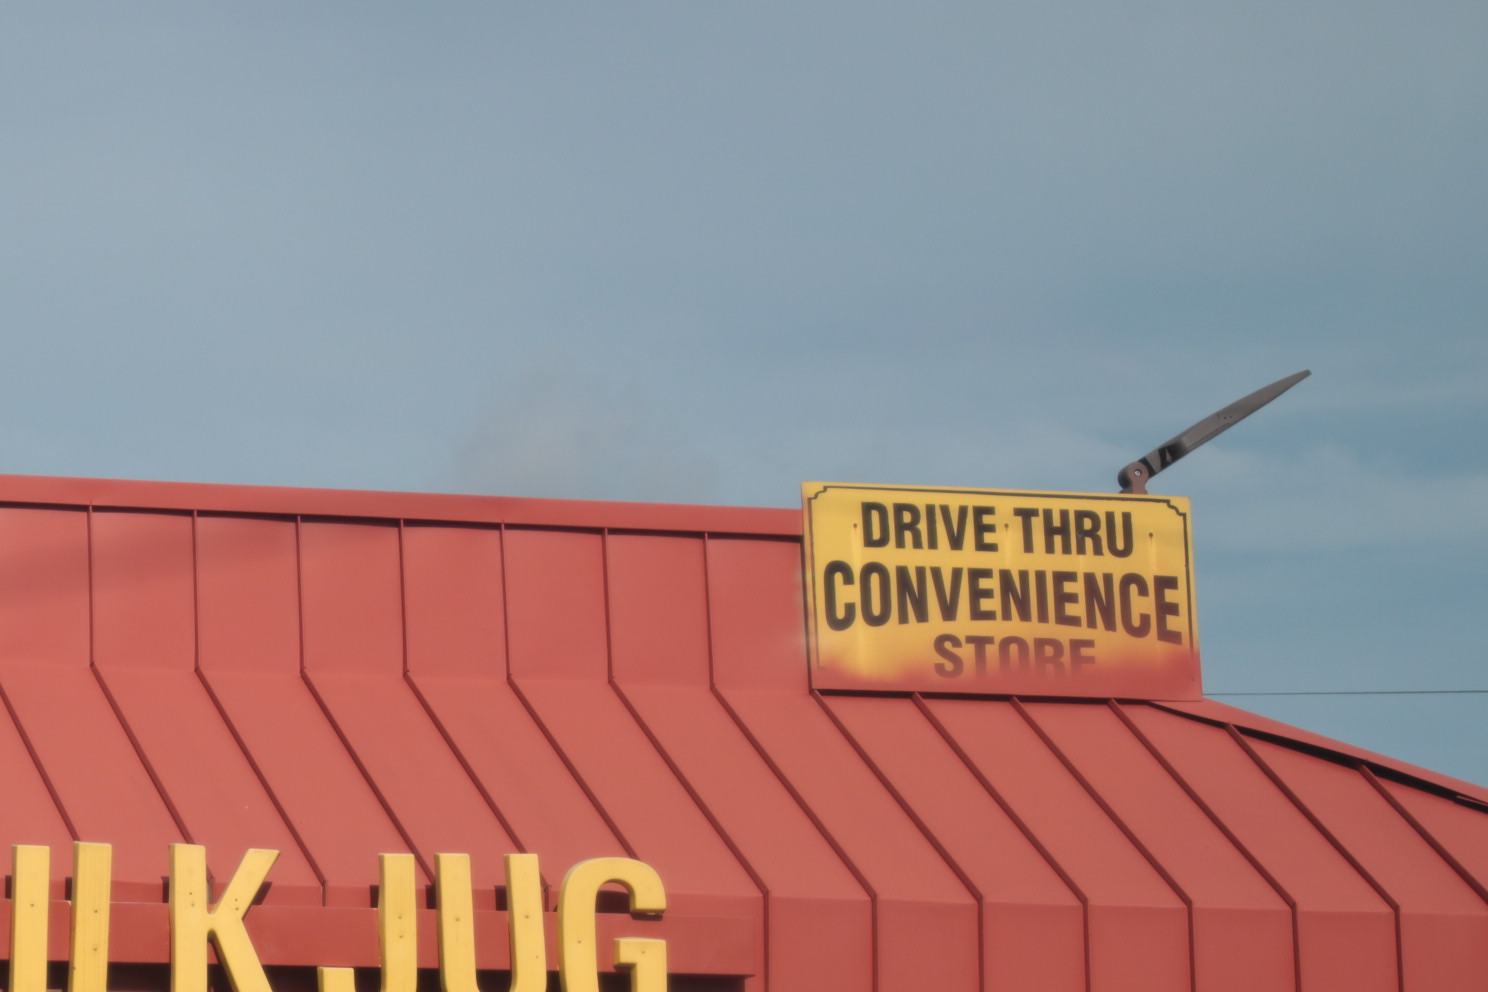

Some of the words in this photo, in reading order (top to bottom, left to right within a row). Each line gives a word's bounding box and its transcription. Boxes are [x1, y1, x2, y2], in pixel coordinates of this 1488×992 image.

[860, 501, 999, 552] DRIVE
[1013, 507, 1134, 558] THRU
[823, 560, 1184, 645] CONVENIENCE
